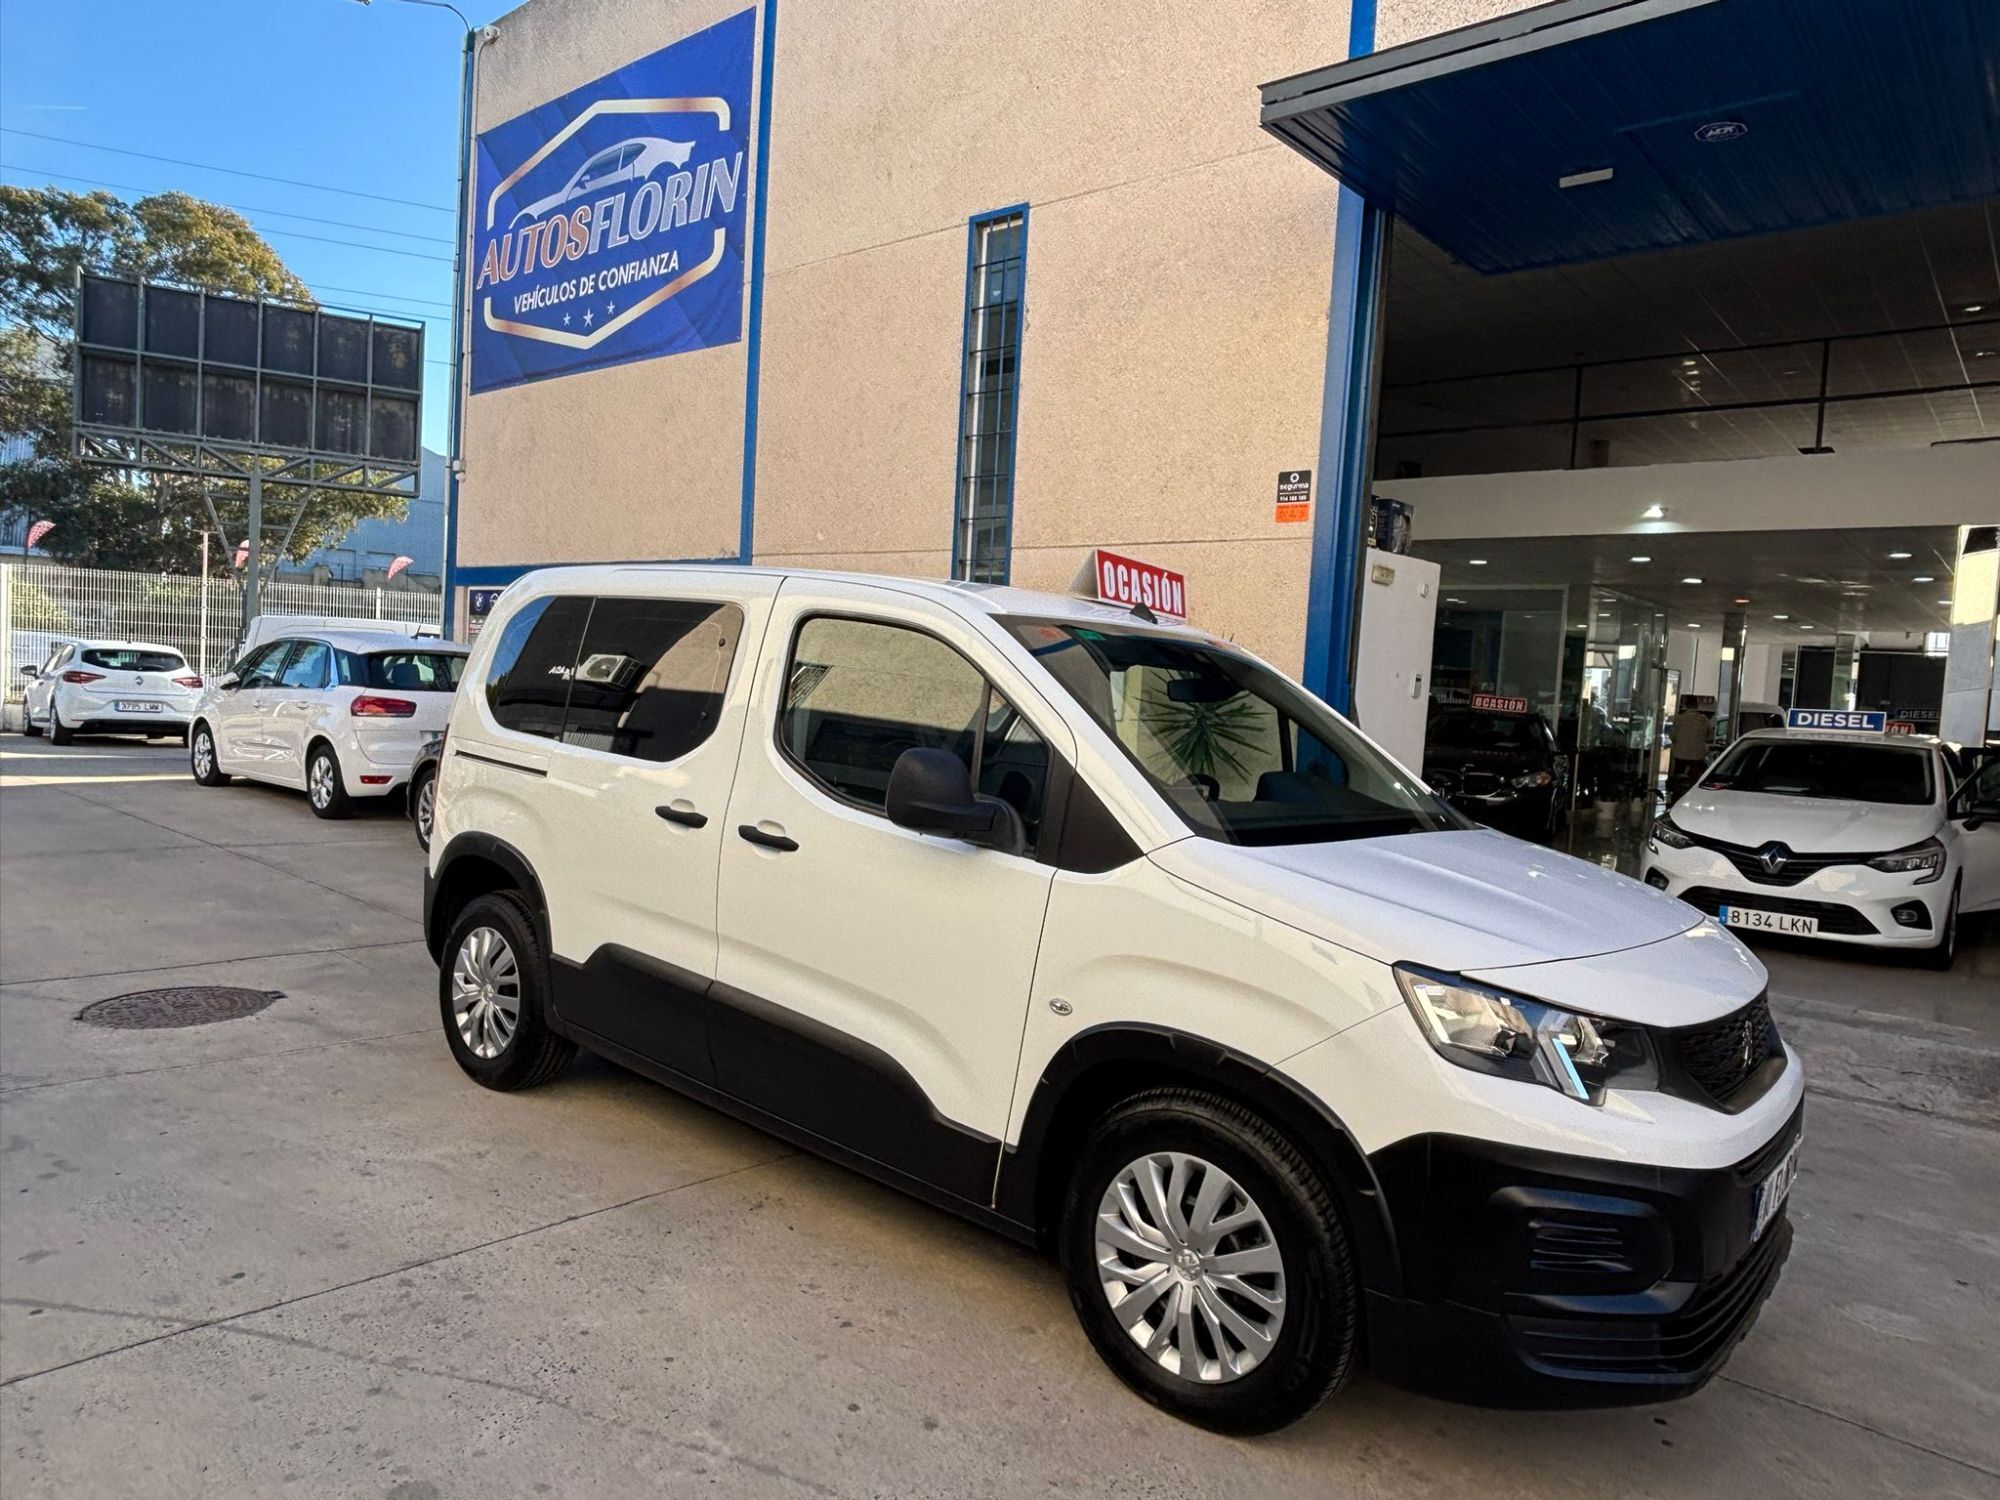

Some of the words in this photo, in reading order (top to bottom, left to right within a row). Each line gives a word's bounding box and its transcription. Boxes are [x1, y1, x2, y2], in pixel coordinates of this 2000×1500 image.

[514, 281, 577, 315] VEHÍCULOS
[579, 274, 596, 298] DE
[599, 249, 679, 291] CONFIANZA
[1103, 560, 1183, 615] OCASIÓN
[1796, 712, 1875, 729] DIESEL
[1731, 910, 1773, 929] 8134
[1779, 916, 1813, 934] LKN
